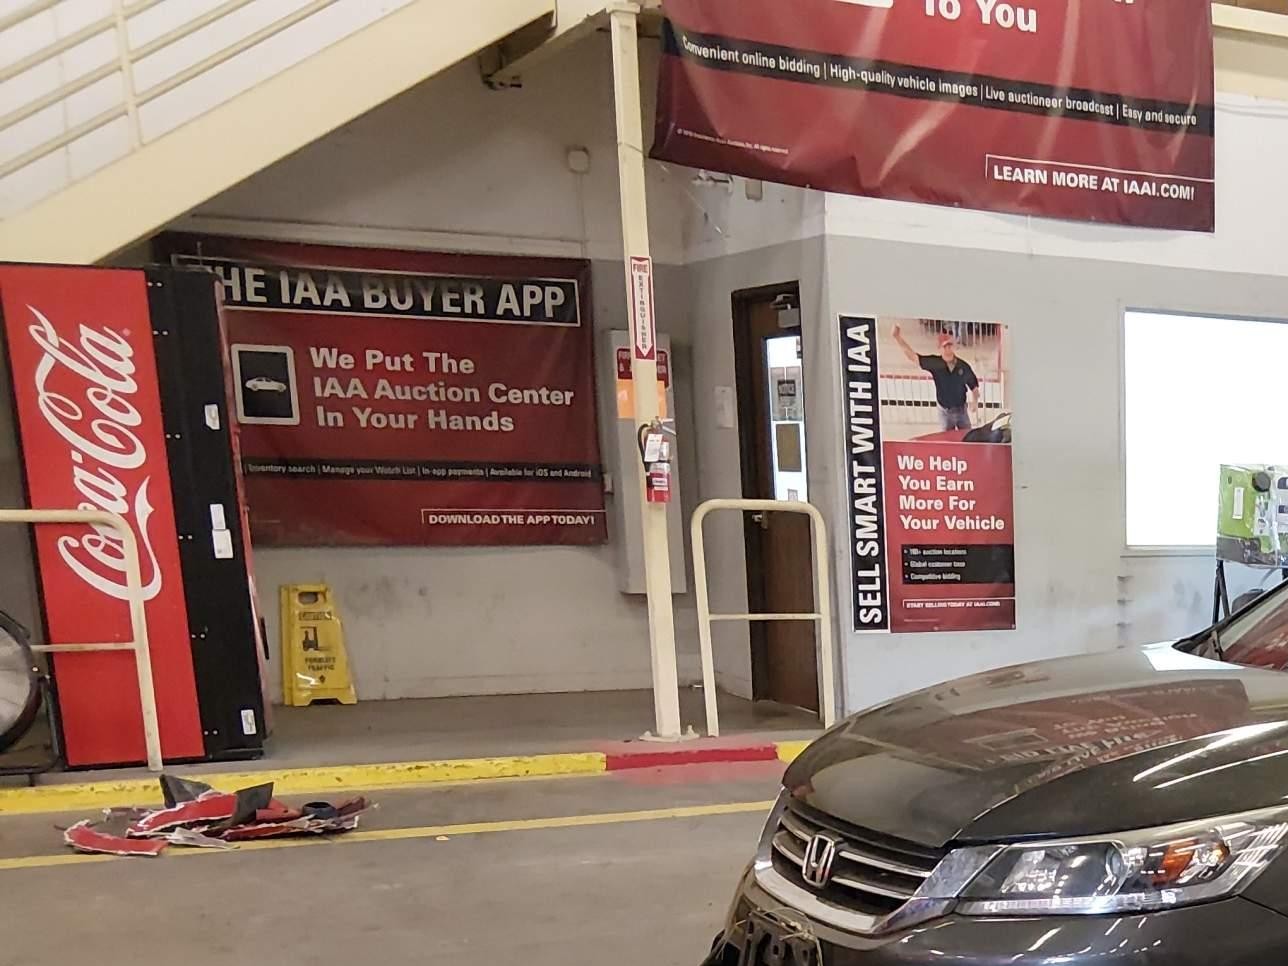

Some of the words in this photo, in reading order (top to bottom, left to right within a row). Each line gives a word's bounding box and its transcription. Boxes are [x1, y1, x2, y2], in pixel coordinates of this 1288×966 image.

[924, 0, 961, 20] To
[977, 0, 1038, 33] You
[682, 35, 740, 63] Convenient
[742, 51, 776, 69] online
[779, 56, 820, 79] bidding
[830, 63, 896, 89] High-quality
[897, 75, 936, 92] vehicle
[938, 79, 978, 98] images
[985, 86, 1005, 102] Live
[1008, 91, 1063, 110] auctioneer
[1065, 96, 1114, 116] broadcast
[1122, 105, 1143, 123] Easy
[1145, 109, 1163, 123] and
[1164, 110, 1198, 125] secure
[993, 165, 1048, 185] LEARN
[1052, 171, 1098, 190] MORE
[1100, 177, 1120, 192] AT
[1123, 179, 1195, 201] IAAI.COM!
[632, 263, 648, 274] FIRE
[213, 266, 268, 303] HE
[279, 270, 352, 307] IAA
[363, 276, 486, 315] BUYER
[496, 283, 566, 318] APP
[309, 347, 355, 370] We
[365, 349, 415, 373] Put
[422, 351, 475, 374] The
[846, 323, 872, 373] IAA
[313, 376, 369, 399] IAA
[374, 378, 480, 403] Auction
[487, 382, 575, 406] Center
[316, 405, 344, 427] In
[352, 406, 419, 430] Your
[427, 408, 515, 432] Hands
[848, 381, 875, 455] WITH
[26, 304, 161, 600] Coca-Cola
[897, 455, 924, 471] We
[929, 455, 968, 475] Help
[288, 464, 316, 474] search
[898, 475, 931, 490] You
[936, 476, 975, 491] Earn
[852, 460, 880, 558] SMART
[899, 495, 944, 510] More
[948, 495, 976, 511] For
[428, 514, 500, 525] DOWNLOAD
[500, 514, 524, 525] THE
[526, 515, 551, 525] APP
[551, 515, 595, 526] TODAY!
[899, 515, 940, 530] Your
[943, 515, 1005, 530] Vehicle
[857, 563, 883, 625] SELL
